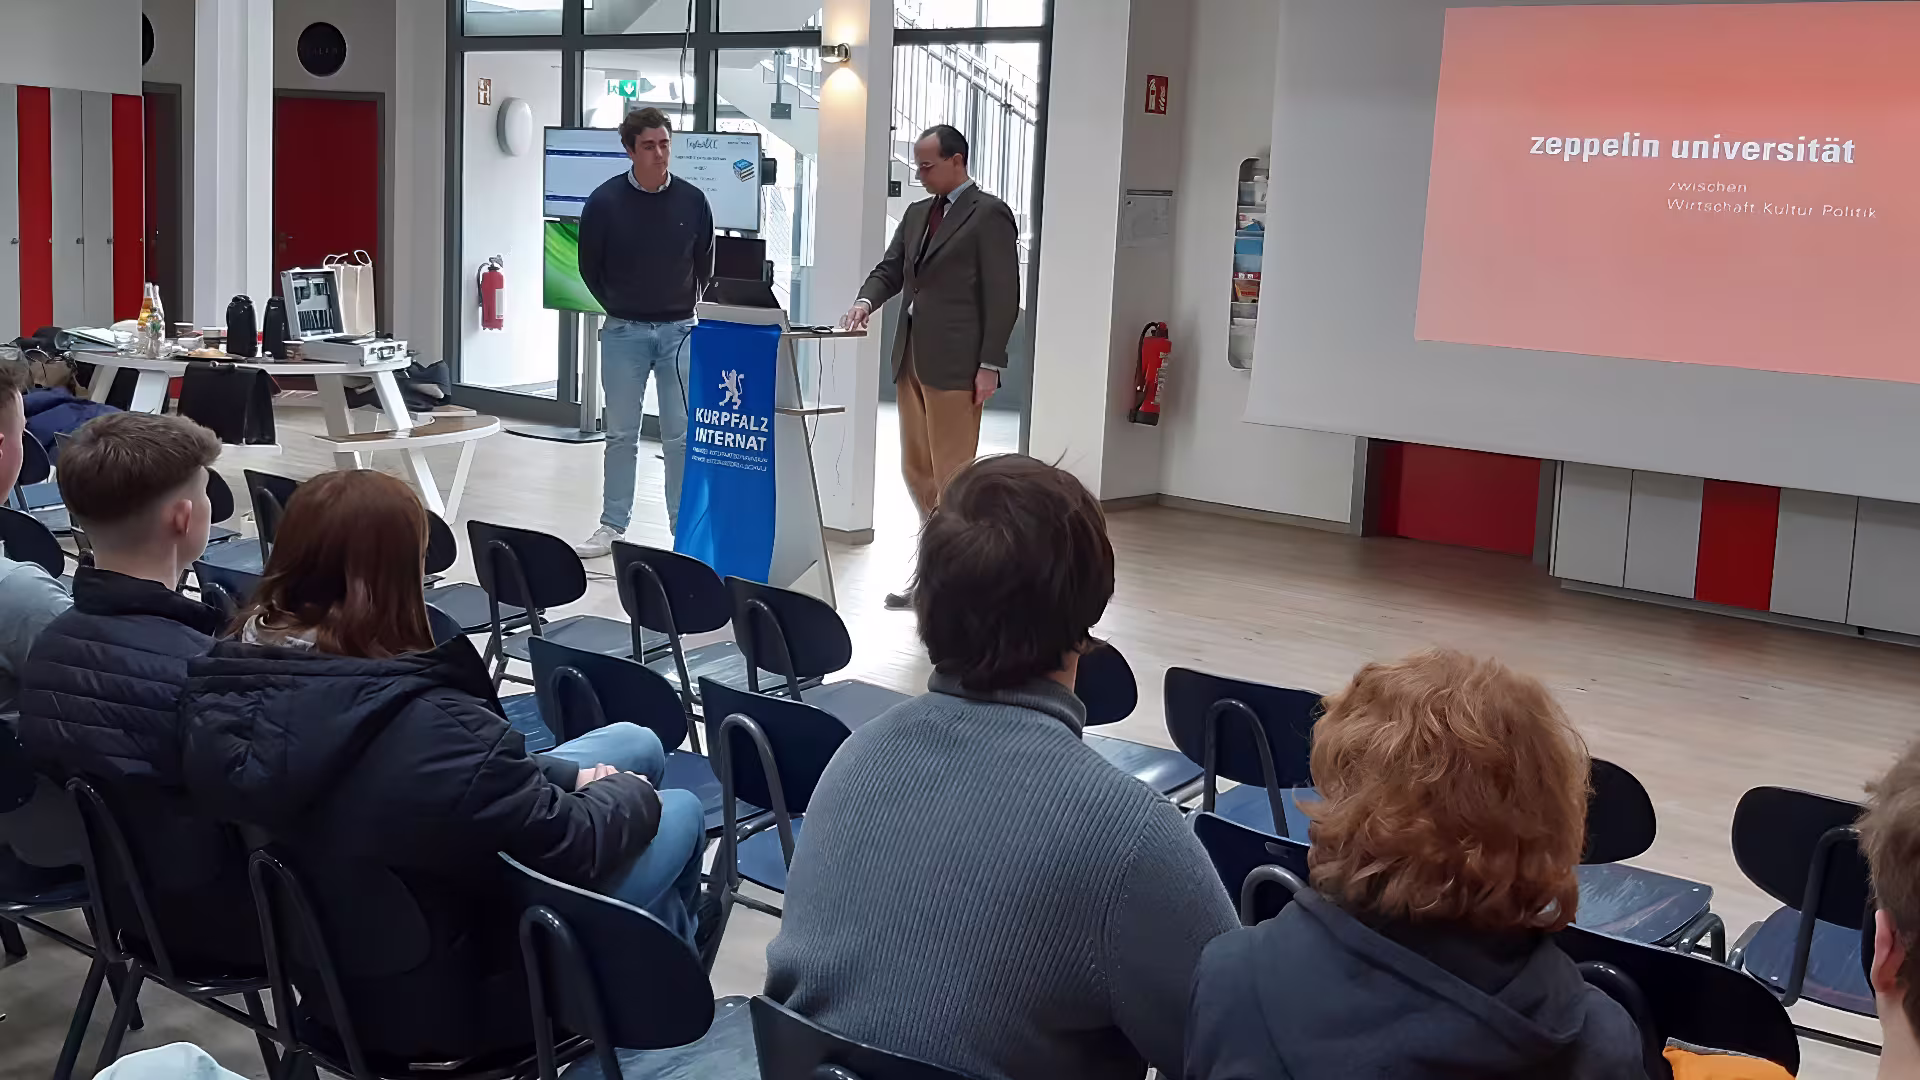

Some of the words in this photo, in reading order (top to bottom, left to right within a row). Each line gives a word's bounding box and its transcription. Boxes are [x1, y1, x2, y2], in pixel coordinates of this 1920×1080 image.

[1529, 131, 1660, 163] zeppelin
[1671, 133, 1856, 164] universität
[1667, 198, 1755, 213] Wirtschaft
[1763, 202, 1813, 216] Kultur
[1822, 204, 1877, 219] Politik
[695, 407, 769, 433] KURPFALZ
[695, 426, 767, 452] INTERNAT
